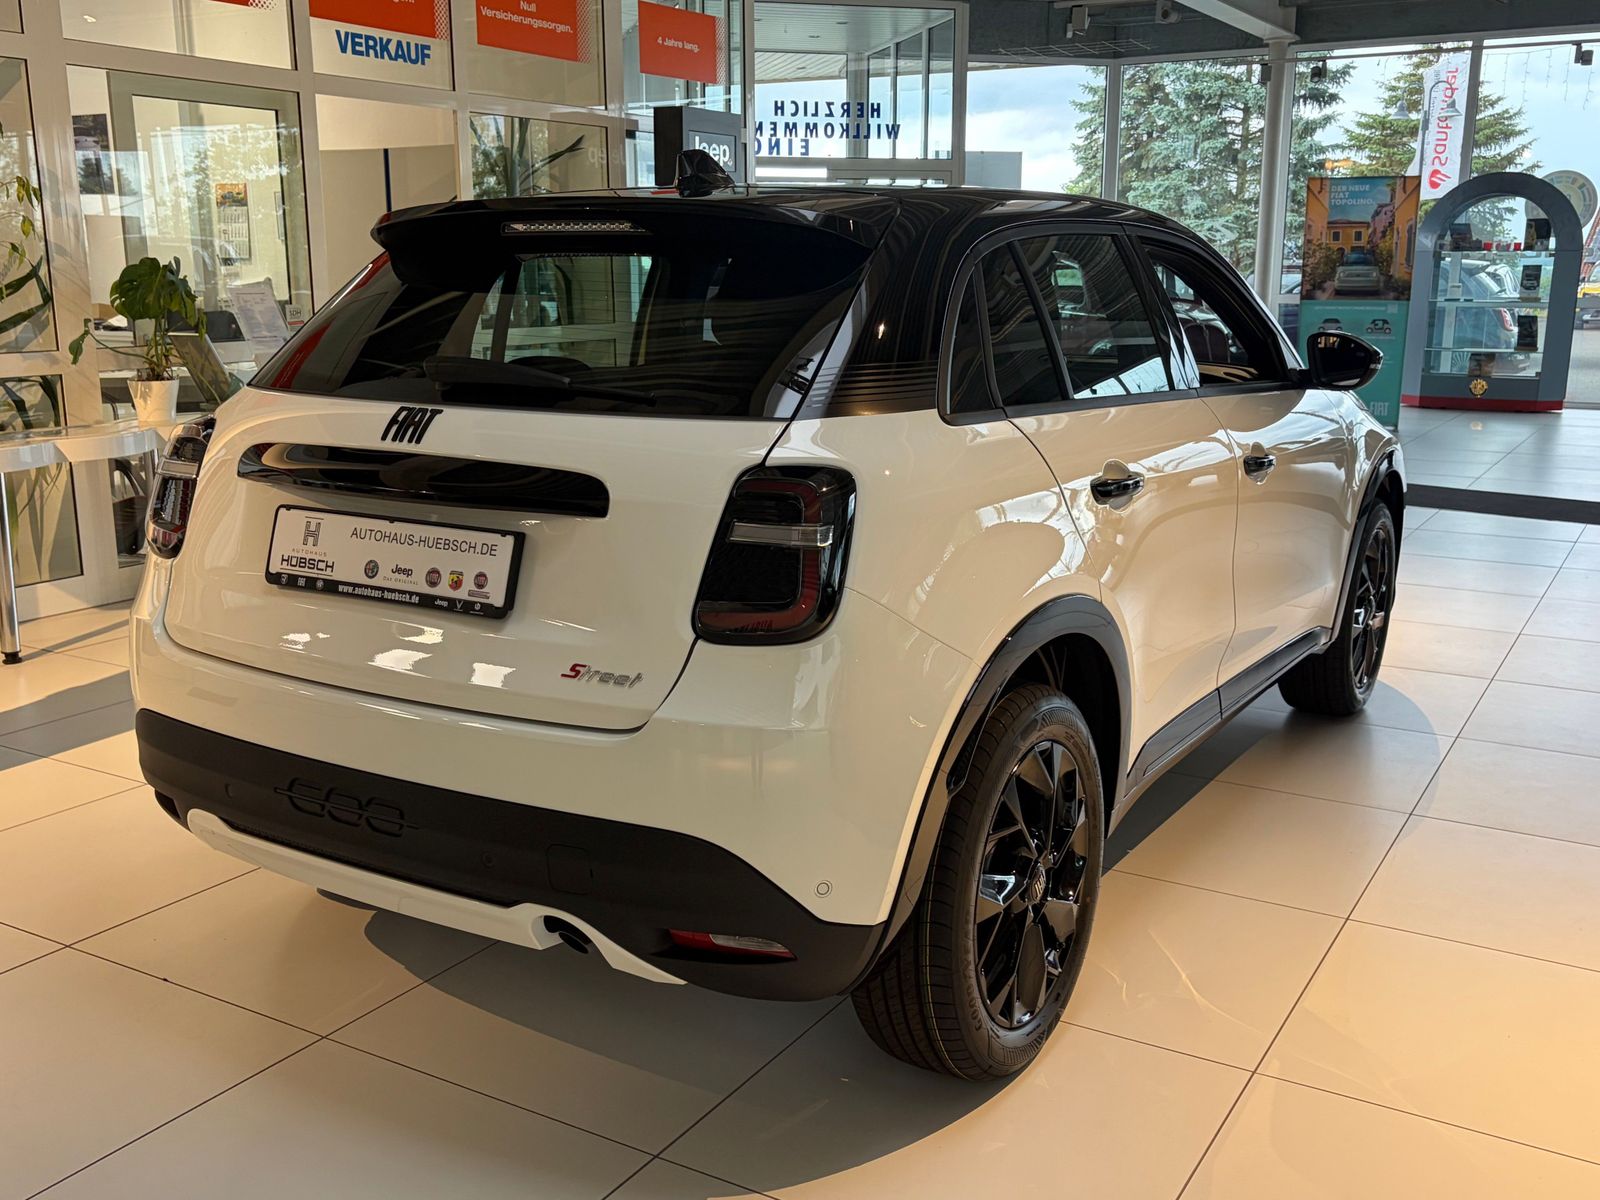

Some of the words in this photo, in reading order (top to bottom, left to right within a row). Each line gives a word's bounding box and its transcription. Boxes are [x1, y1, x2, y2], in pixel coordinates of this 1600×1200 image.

[520, 2, 537, 12] Null
[480, 6, 574, 33] Versicherungssorgen.
[335, 29, 431, 66] VERKAUF
[657, 36, 663, 45] 4
[664, 37, 683, 48] Jahre
[1370, 402, 1390, 416] FIAT
[381, 406, 444, 445] FIAT
[350, 527, 499, 557] AUTOHAUS-HUEBSCH.DE
[292, 548, 328, 558] AUTOHAUS
[280, 554, 335, 573] HÜBSCH
[391, 564, 413, 577] Jeep
[338, 584, 420, 604] www.autohaus-huebsch.de
[560, 663, 644, 689] Street
